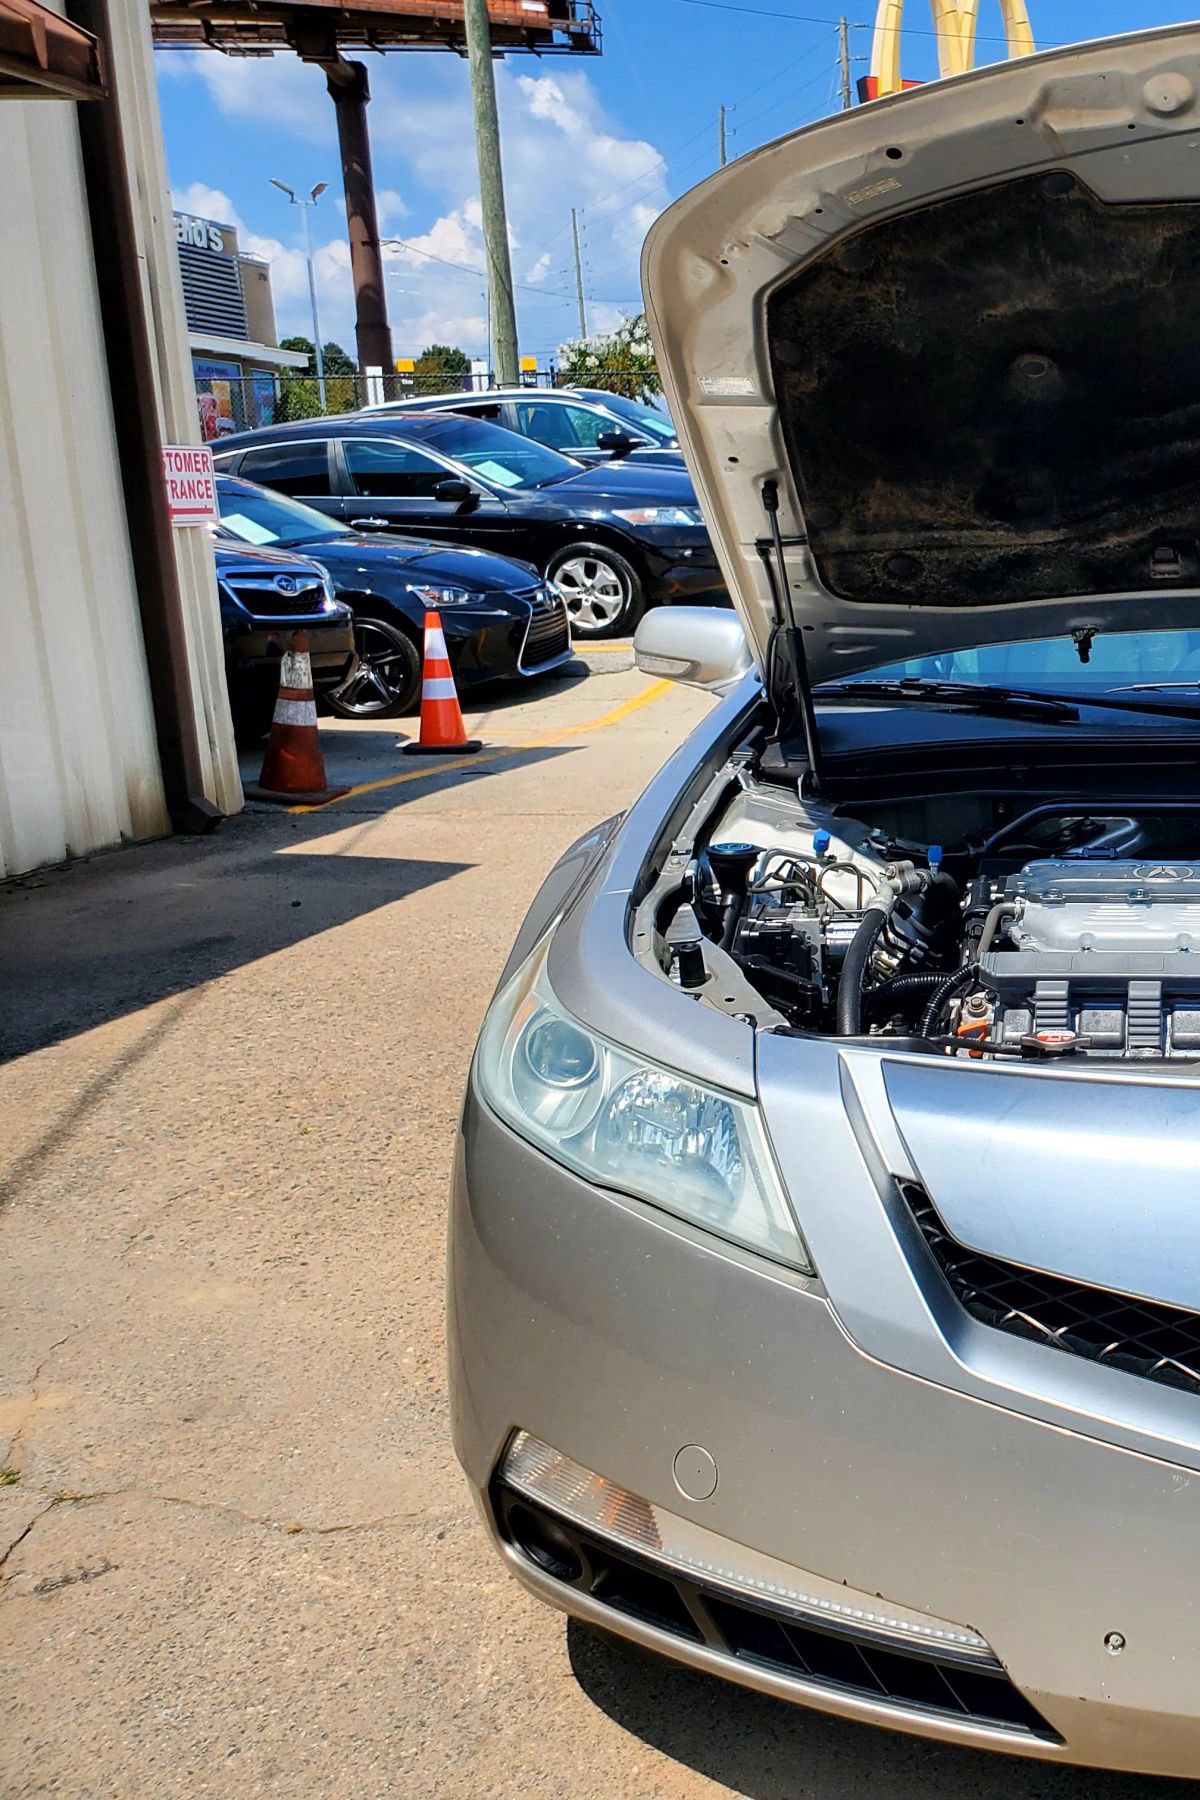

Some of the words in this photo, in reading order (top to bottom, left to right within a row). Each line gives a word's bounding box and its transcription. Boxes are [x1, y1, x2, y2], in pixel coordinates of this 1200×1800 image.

[174, 215, 224, 252] ald's
[165, 452, 210, 473] TOMER
[167, 479, 213, 500] RANCE
